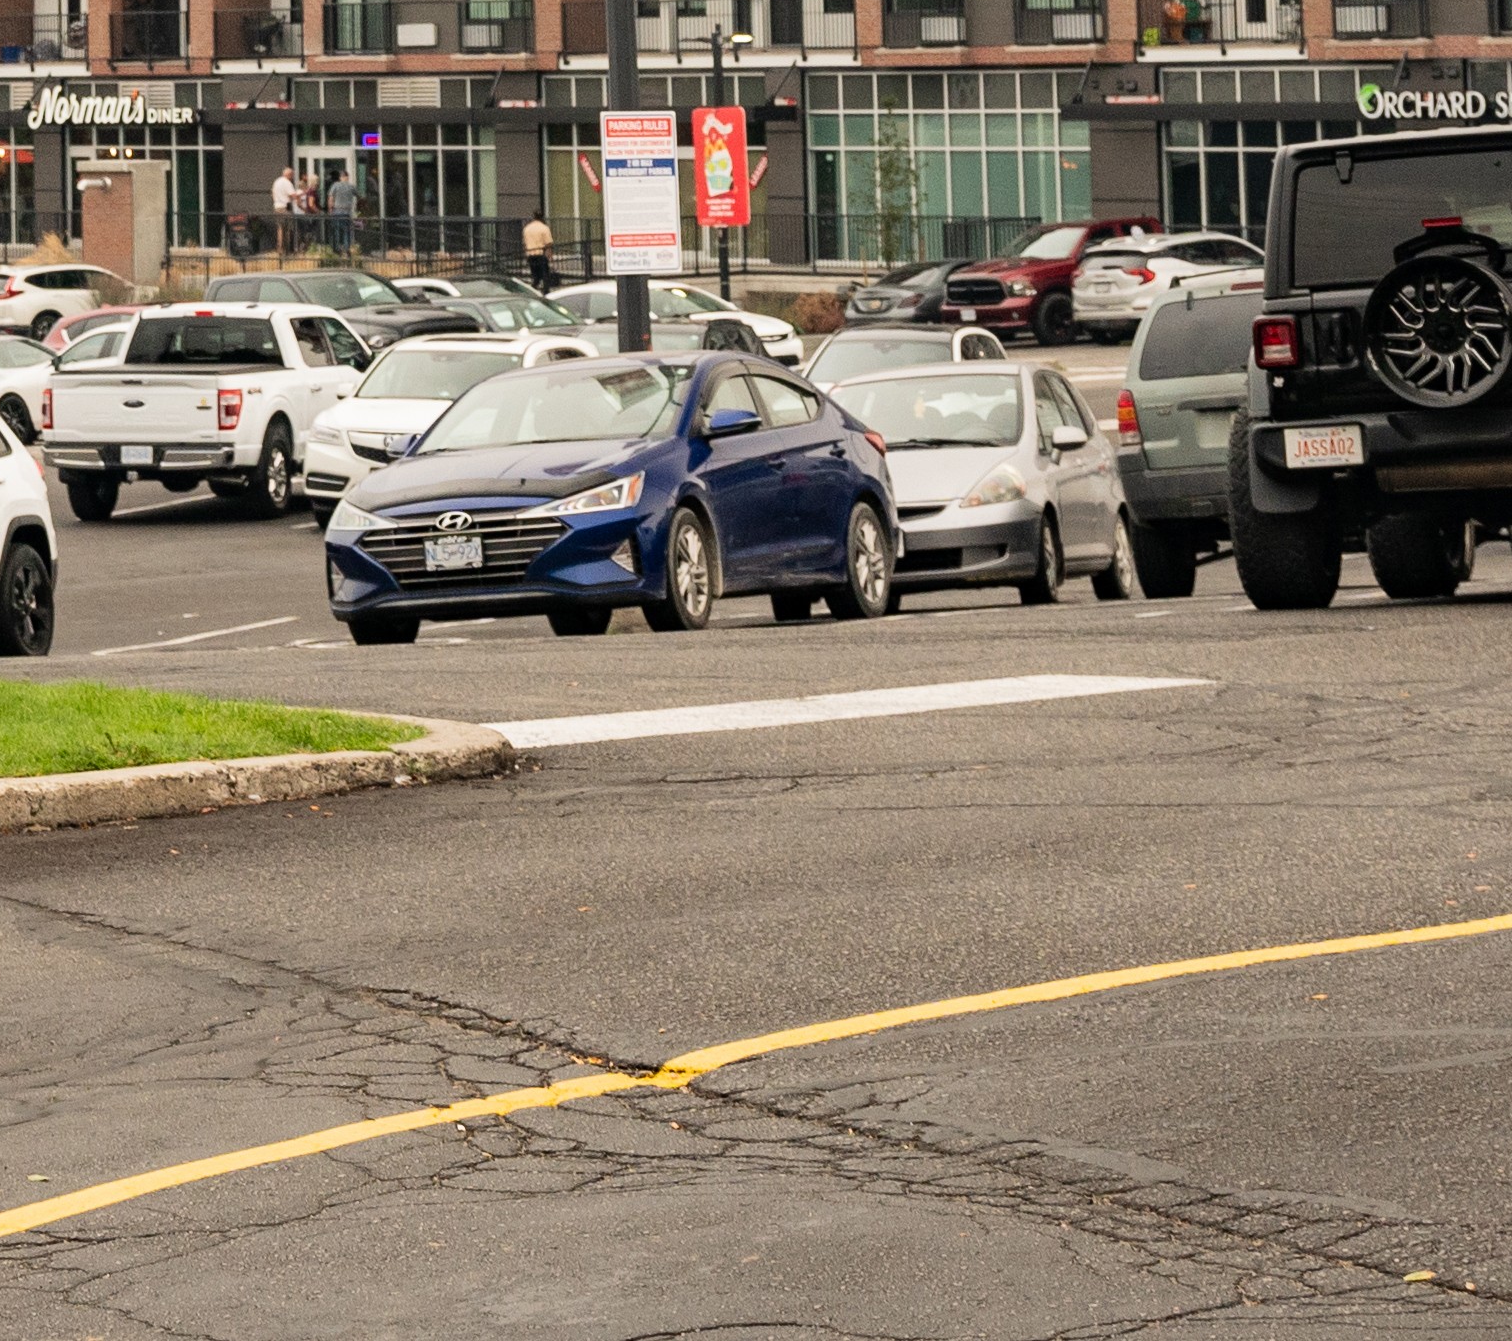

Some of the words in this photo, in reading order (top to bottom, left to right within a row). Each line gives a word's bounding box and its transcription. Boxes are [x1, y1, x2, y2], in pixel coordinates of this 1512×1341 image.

[27, 85, 145, 130] Norman's
[146, 107, 194, 124] DINER
[1359, 91, 1486, 118] ORCHARD
[608, 120, 643, 131] PARKING
[643, 120, 668, 131] RULES
[1294, 437, 1355, 457] JASSA02
